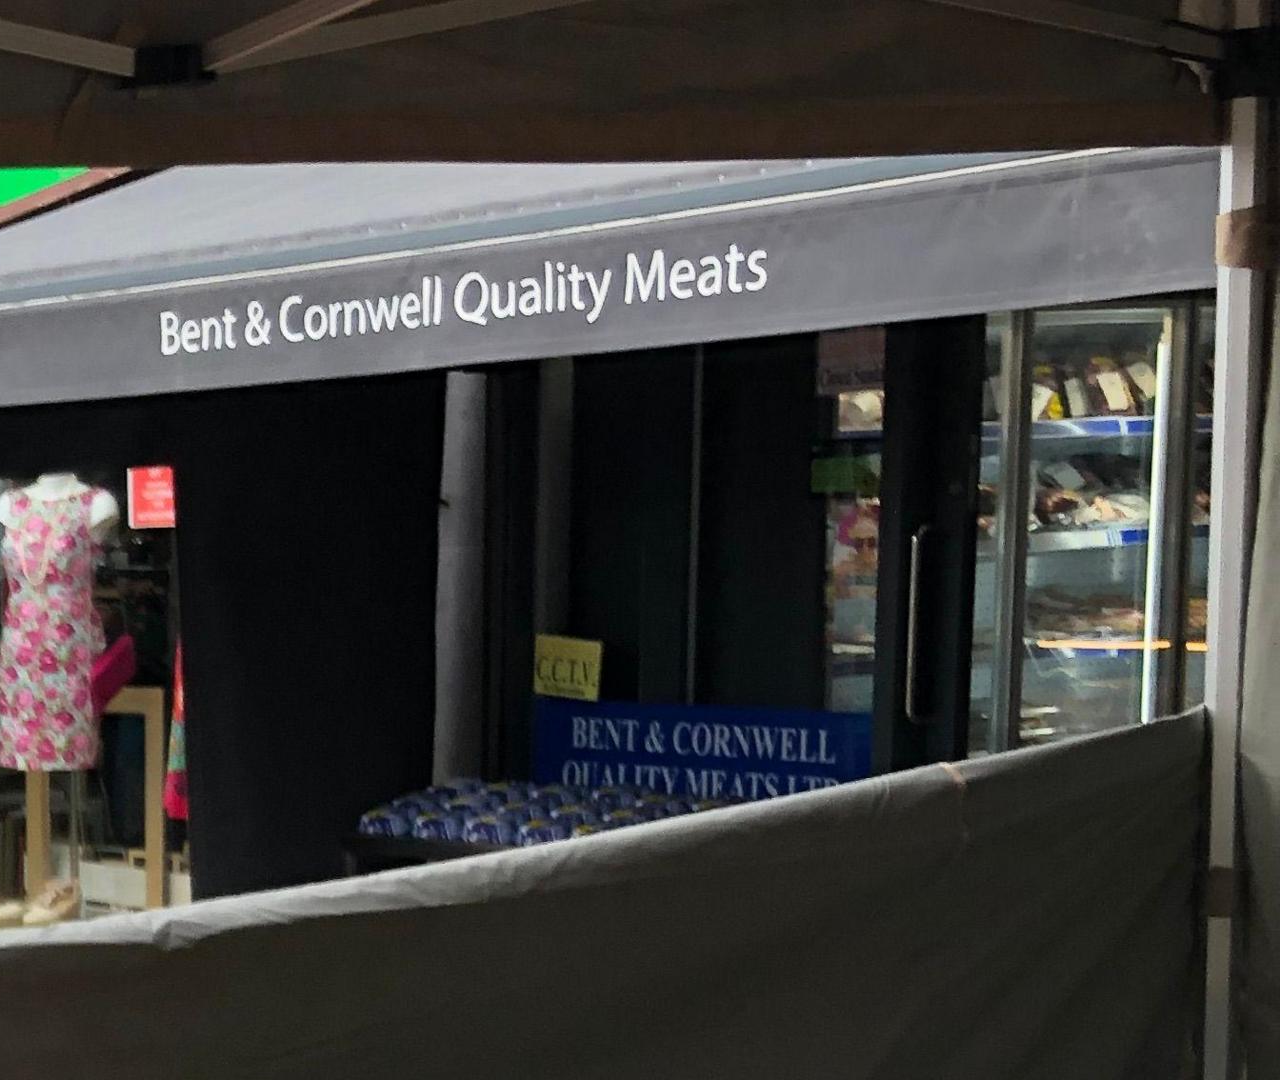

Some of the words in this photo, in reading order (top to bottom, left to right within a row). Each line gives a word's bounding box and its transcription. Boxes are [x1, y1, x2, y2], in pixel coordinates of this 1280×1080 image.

[158, 307, 237, 357] Bent
[243, 300, 272, 348] &
[278, 276, 443, 344] Cornwell
[453, 261, 612, 326] Quality
[623, 243, 769, 305] Meats
[571, 716, 639, 751] BENT
[644, 720, 665, 753] &
[672, 721, 836, 765] CORNWELL
[686, 766, 779, 800] MEATS
